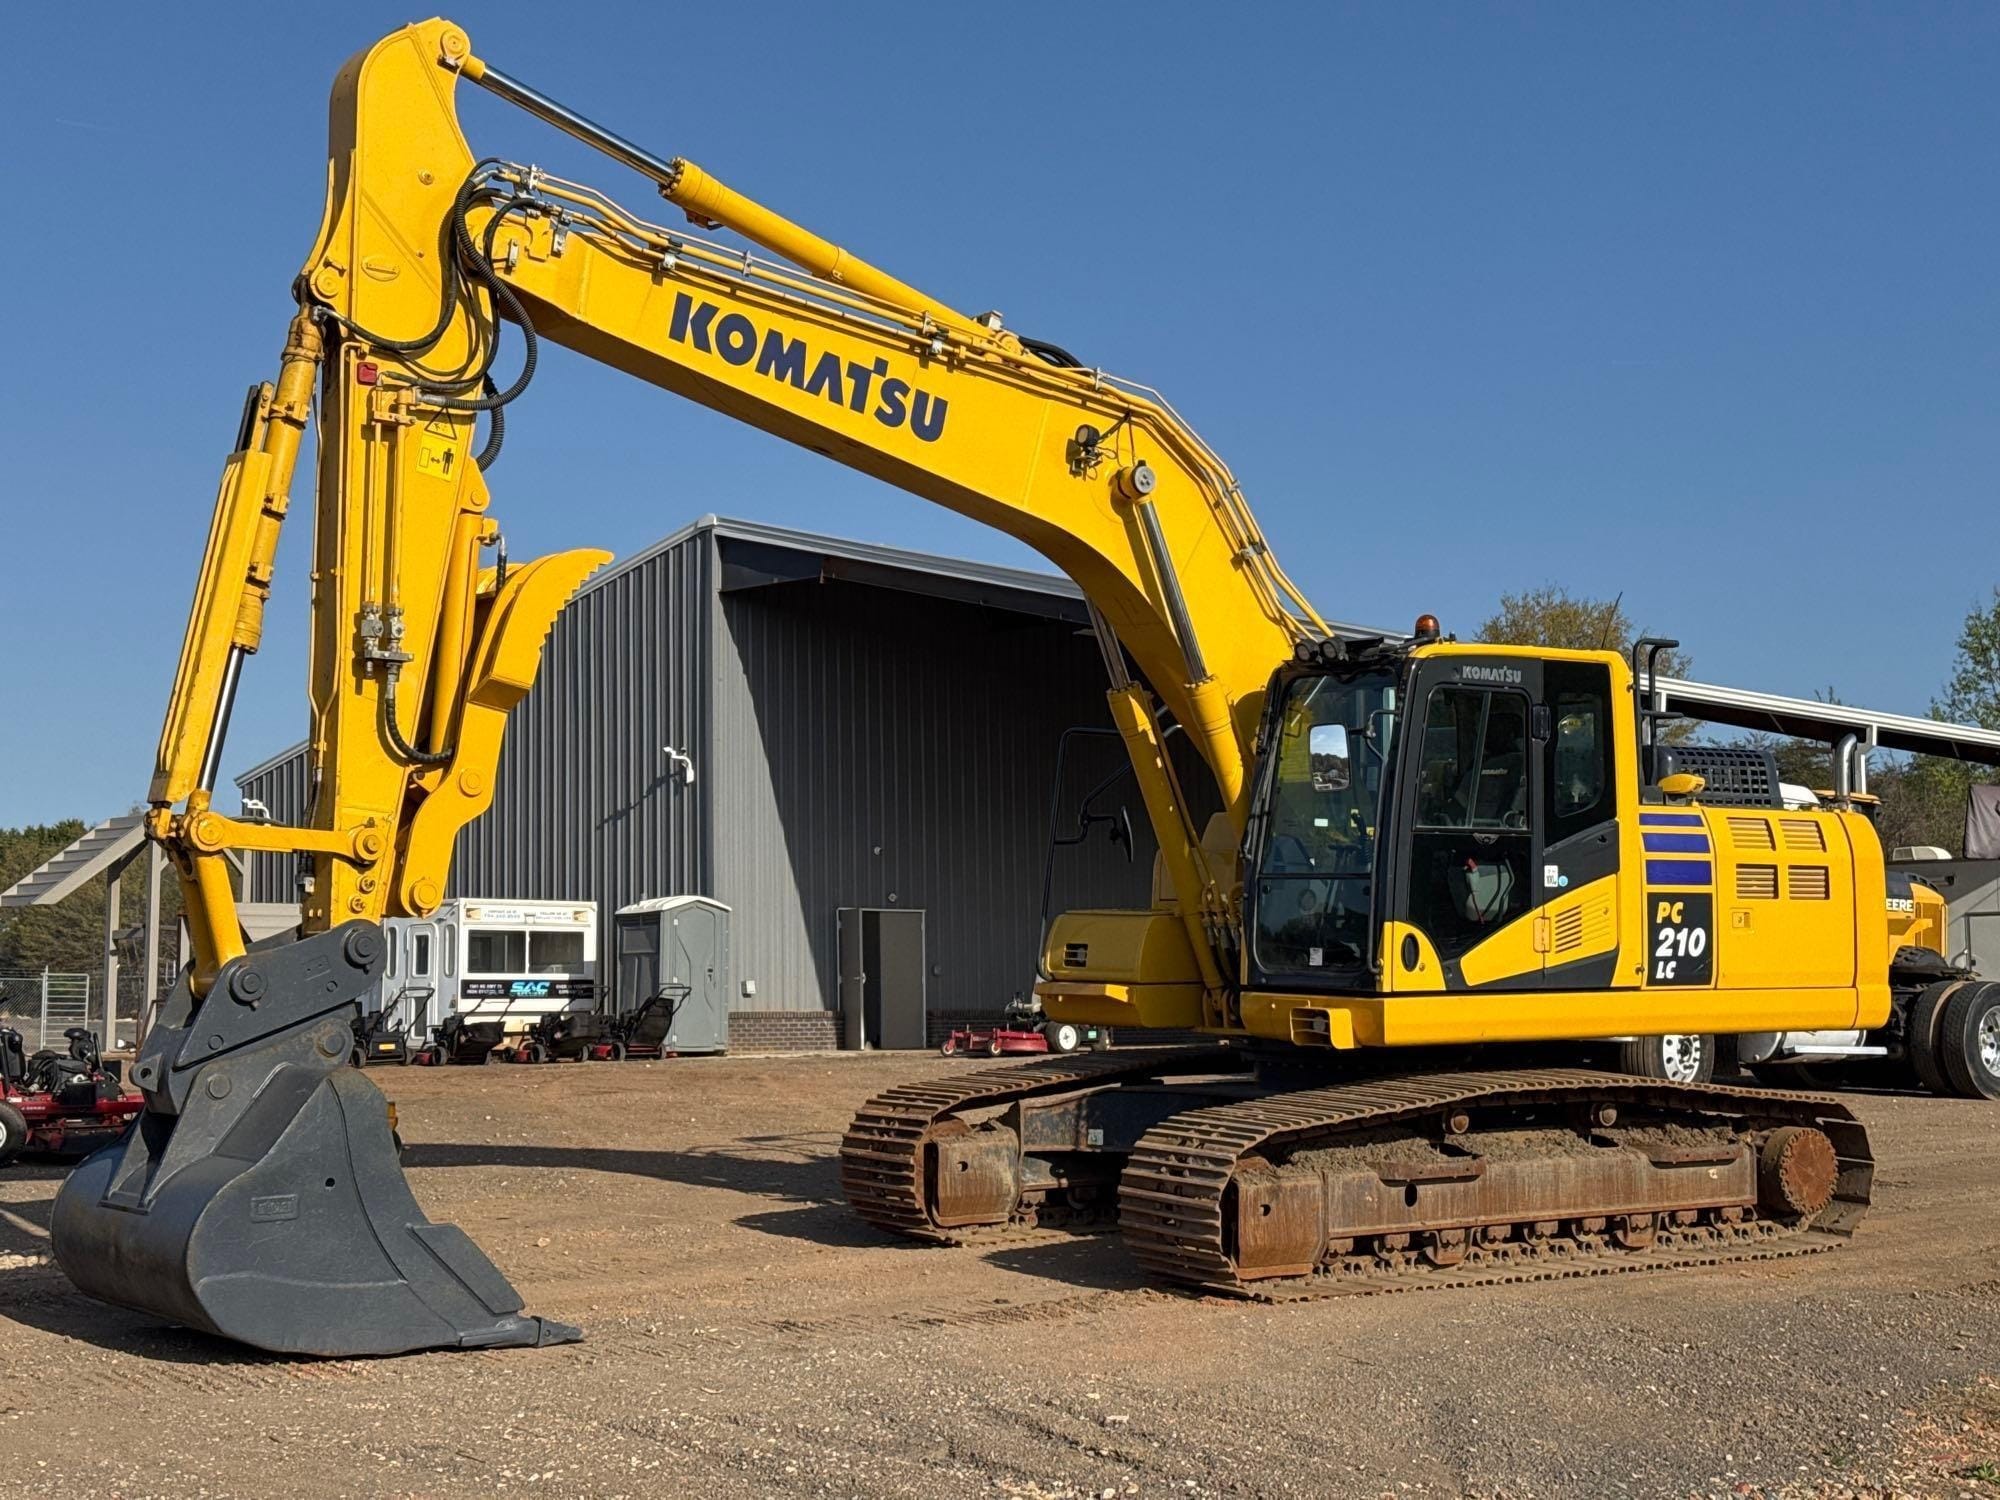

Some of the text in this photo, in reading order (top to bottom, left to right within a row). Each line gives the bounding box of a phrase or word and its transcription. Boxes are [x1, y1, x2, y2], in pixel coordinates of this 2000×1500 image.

[668, 291, 949, 442] KOMATSU
[1462, 665, 1522, 683] KOMATSU
[1656, 902, 1684, 924] PC
[1886, 898, 1914, 912] EERE
[1655, 927, 1706, 957] 210
[1655, 961, 1677, 979] LC
[510, 981, 551, 993] SAC
